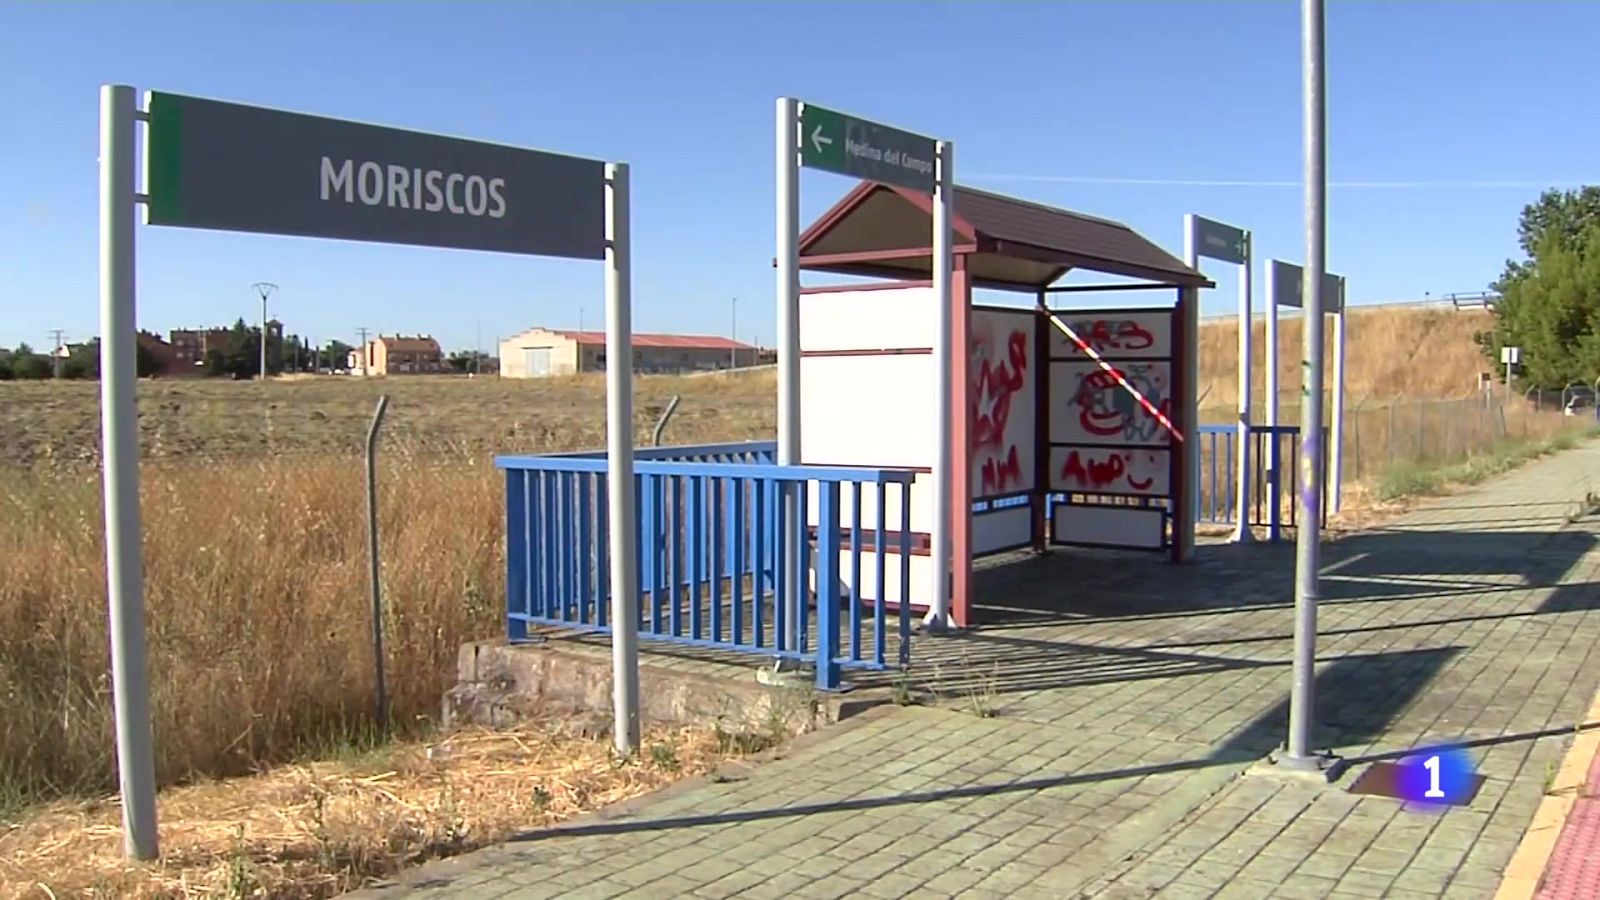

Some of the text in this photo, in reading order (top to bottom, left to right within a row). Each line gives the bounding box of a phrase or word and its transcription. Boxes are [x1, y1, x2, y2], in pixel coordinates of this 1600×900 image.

[845, 138, 932, 174] Medina del Campo
[320, 156, 507, 218] MORISCOS
